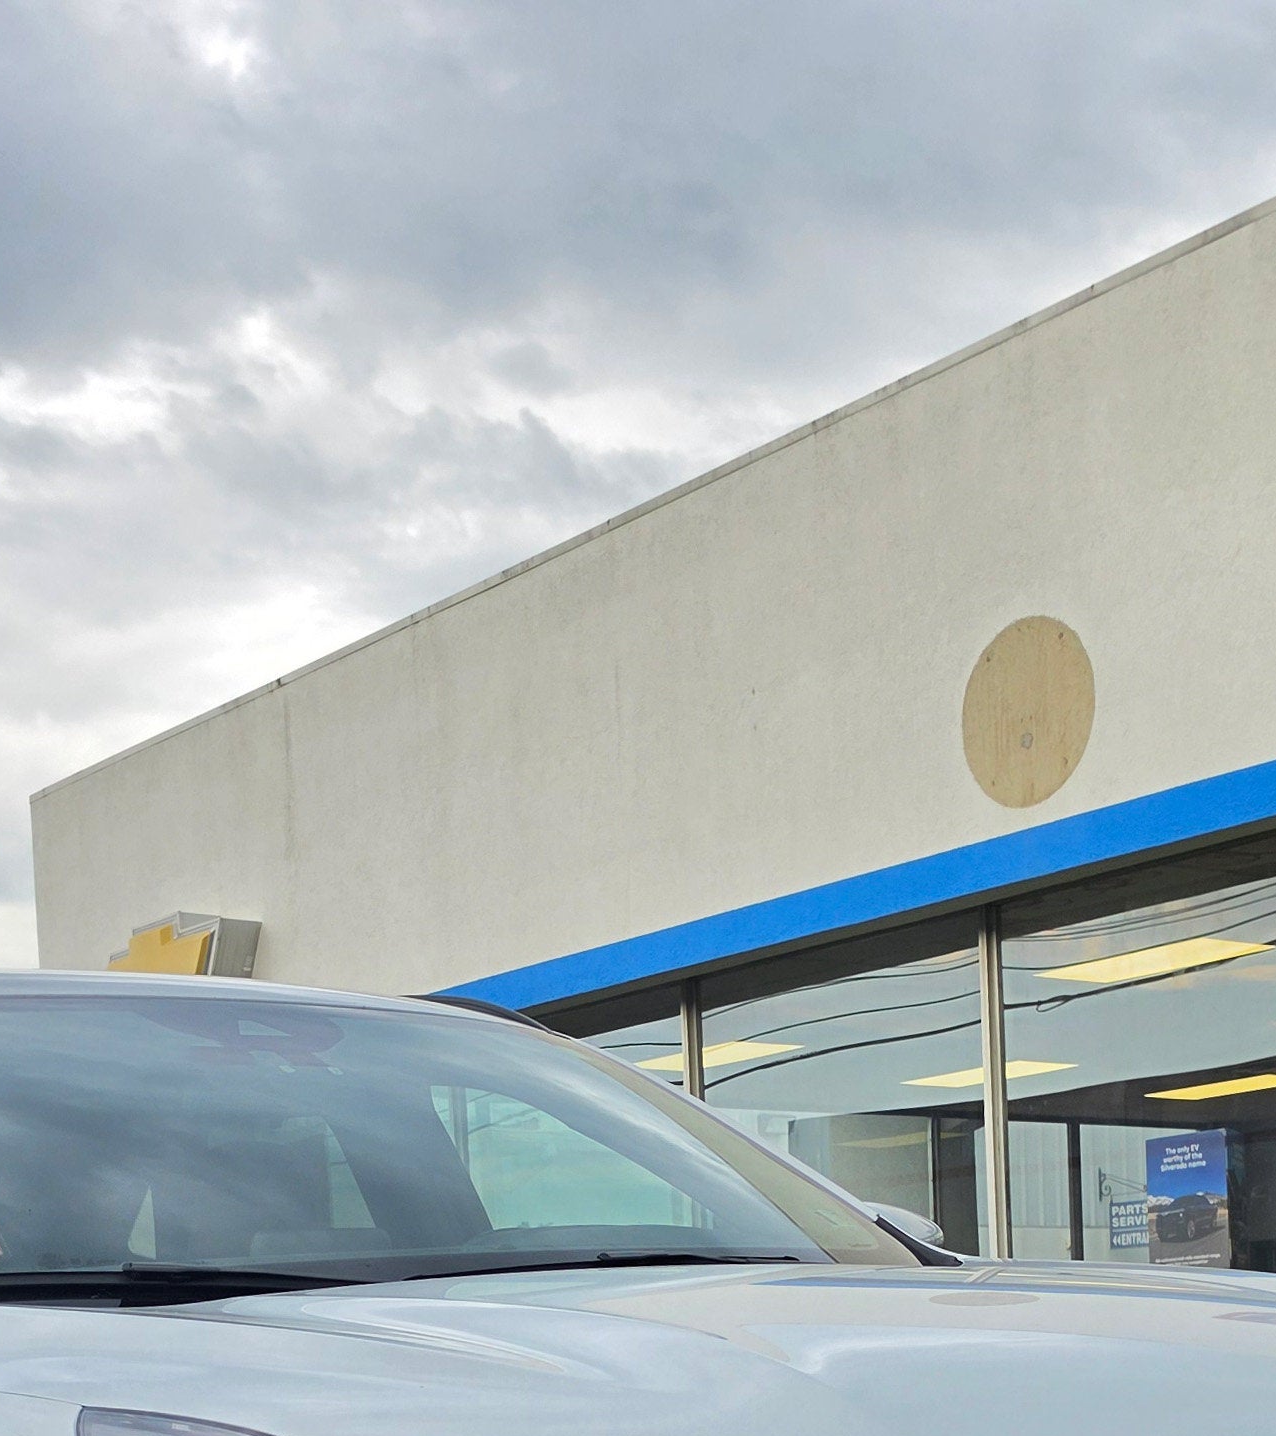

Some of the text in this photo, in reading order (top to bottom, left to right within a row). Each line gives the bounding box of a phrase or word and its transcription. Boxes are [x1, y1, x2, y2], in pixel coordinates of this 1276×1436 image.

[1177, 1146, 1189, 1154] only
[1191, 1144, 1199, 1152] EV
[1111, 1204, 1148, 1216] PARTS
[1112, 1215, 1147, 1228] SERVI
